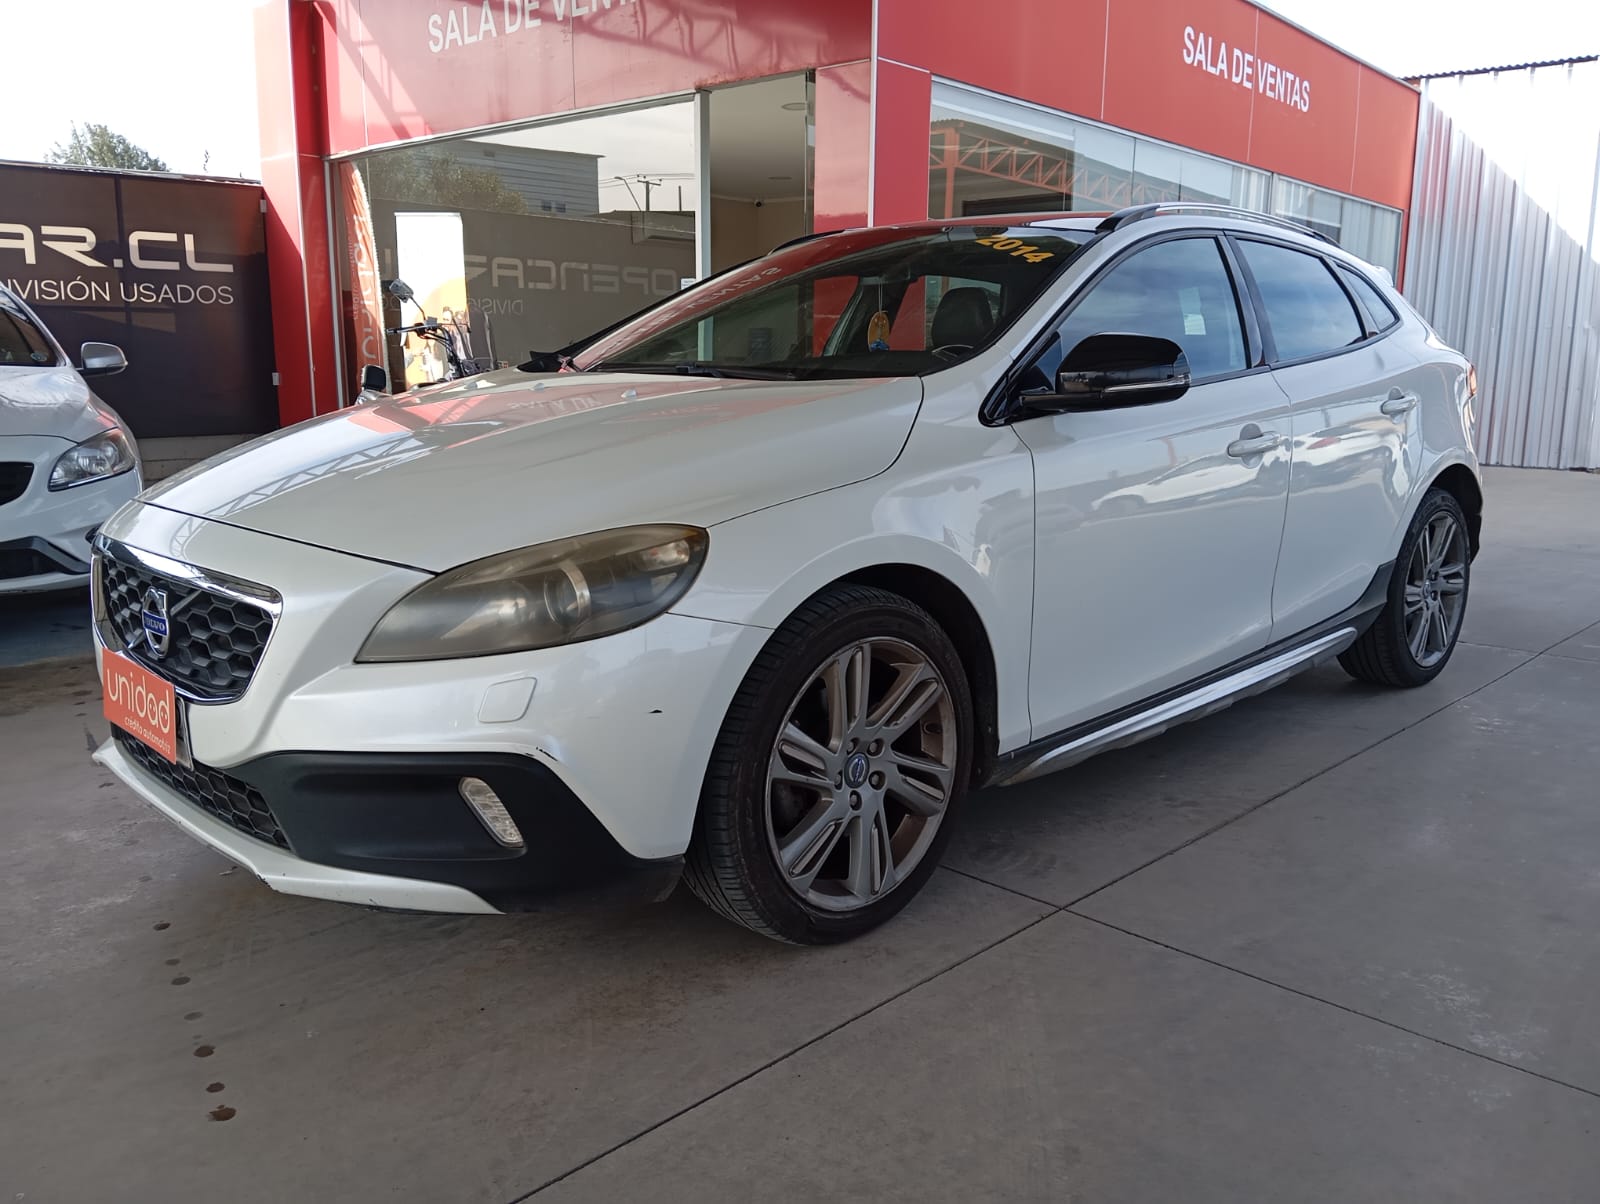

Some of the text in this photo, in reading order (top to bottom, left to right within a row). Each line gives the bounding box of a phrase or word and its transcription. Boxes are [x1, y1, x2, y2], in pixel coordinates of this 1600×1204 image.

[428, 0, 498, 53] SALA
[504, 0, 542, 34] DE
[1183, 25, 1310, 112] SALA DE VENTAS
[975, 234, 1055, 263] 2014
[119, 282, 234, 305] USADOS
[106, 667, 171, 735] unidad
